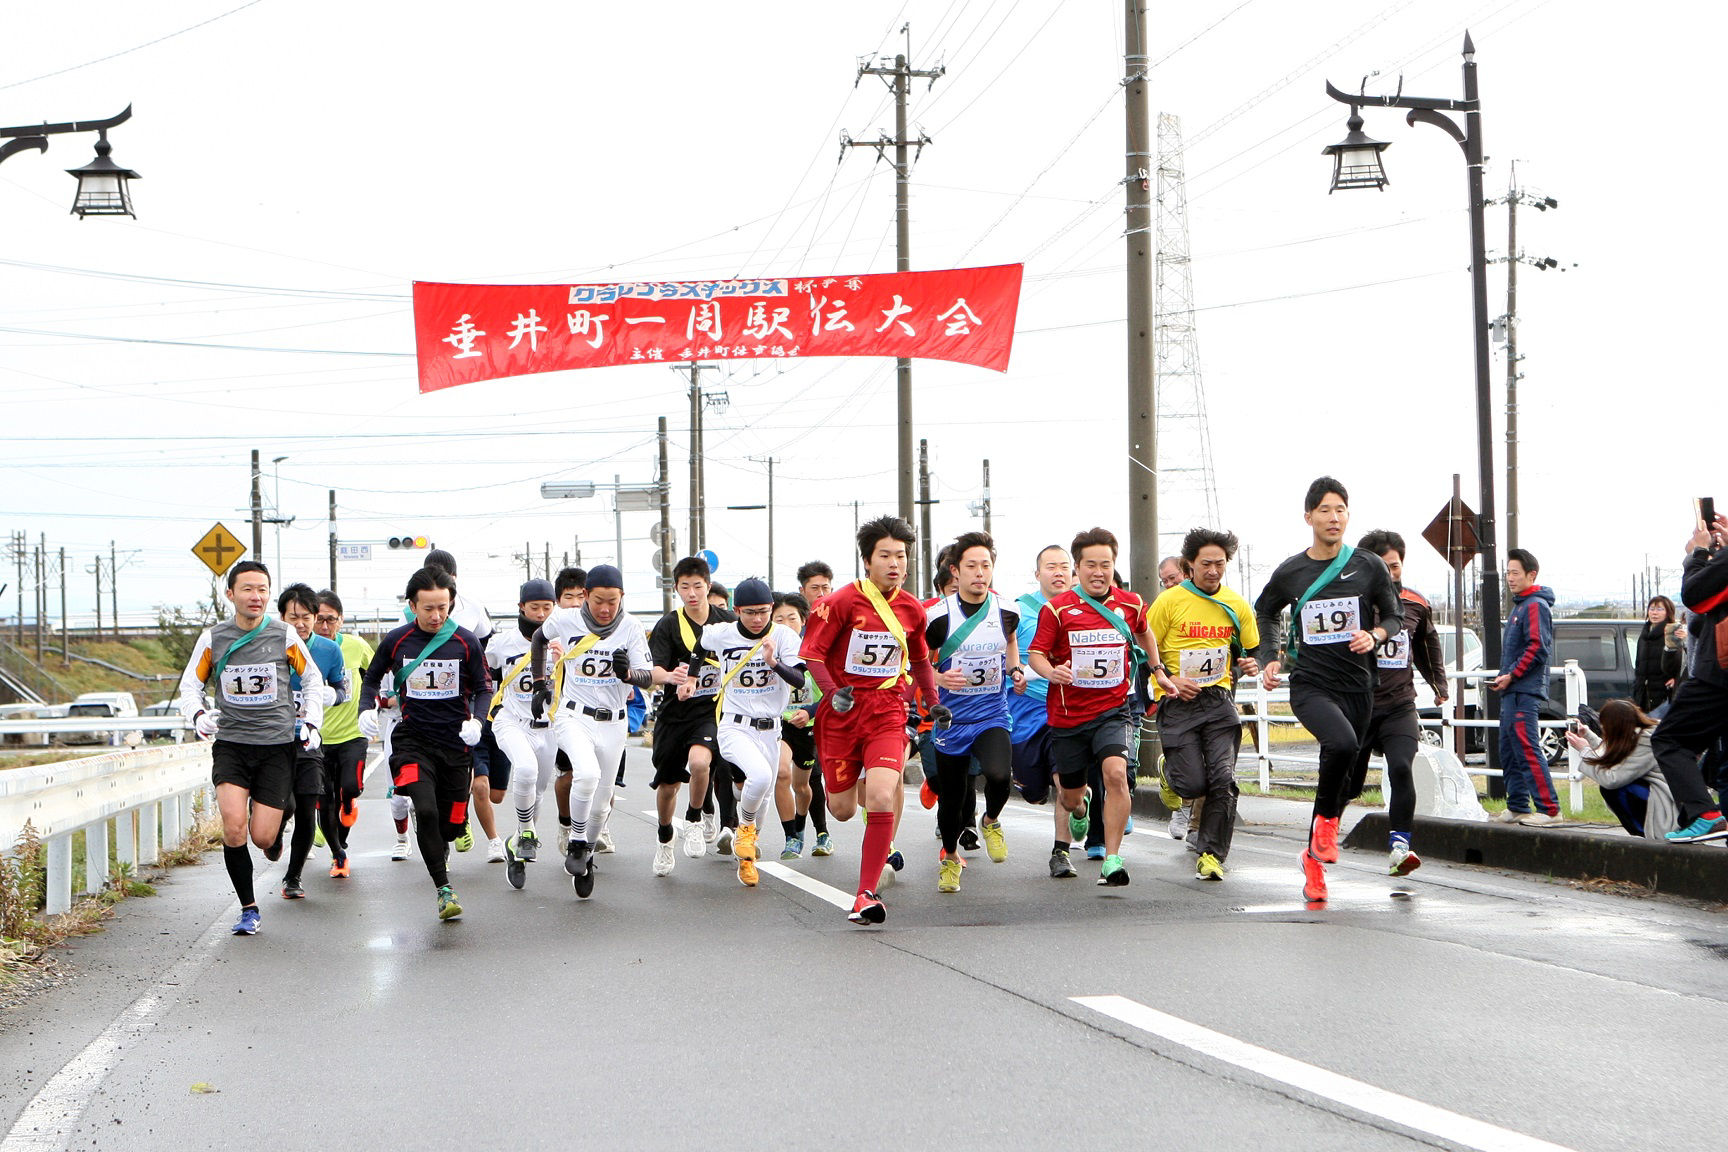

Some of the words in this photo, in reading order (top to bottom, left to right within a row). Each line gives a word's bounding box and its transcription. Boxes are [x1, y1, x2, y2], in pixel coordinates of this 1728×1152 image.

[575, 281, 783, 302] クラレプラスチックス
[442, 292, 982, 359] 垂井町一周駅伝大会
[1315, 611, 1347, 633] 19
[861, 644, 896, 666] 57
[582, 657, 613, 678] 62
[971, 668, 986, 686] 3
[1093, 658, 1108, 679] 5
[1200, 658, 1213, 676] 4
[232, 675, 265, 694] 13
[425, 670, 438, 689] 1
[519, 674, 533, 692] 6
[740, 669, 769, 687] 63
[834, 759, 848, 782] 2
